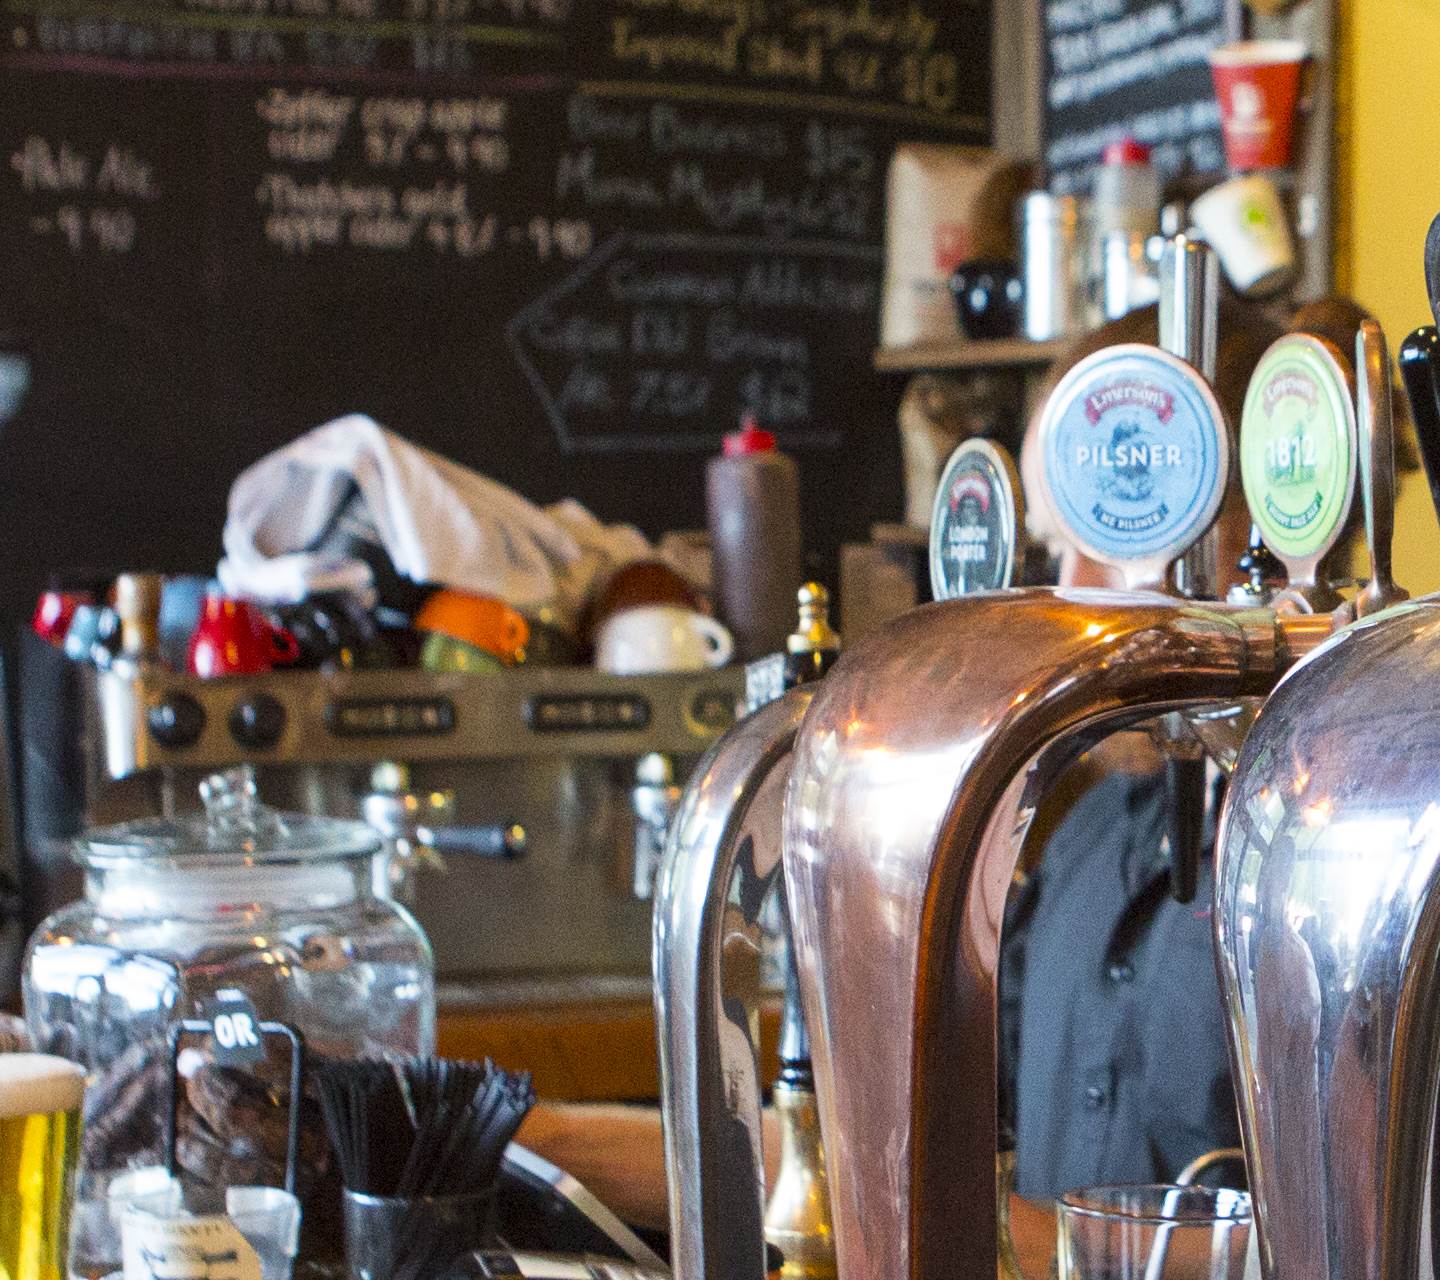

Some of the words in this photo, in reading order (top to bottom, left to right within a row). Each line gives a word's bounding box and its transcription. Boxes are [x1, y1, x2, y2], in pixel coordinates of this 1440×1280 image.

[1091, 383, 1168, 411] Emerson's
[1075, 443, 1182, 467] PILSNER
[1266, 439, 1317, 468] 1812
[214, 1013, 259, 1049] OR
